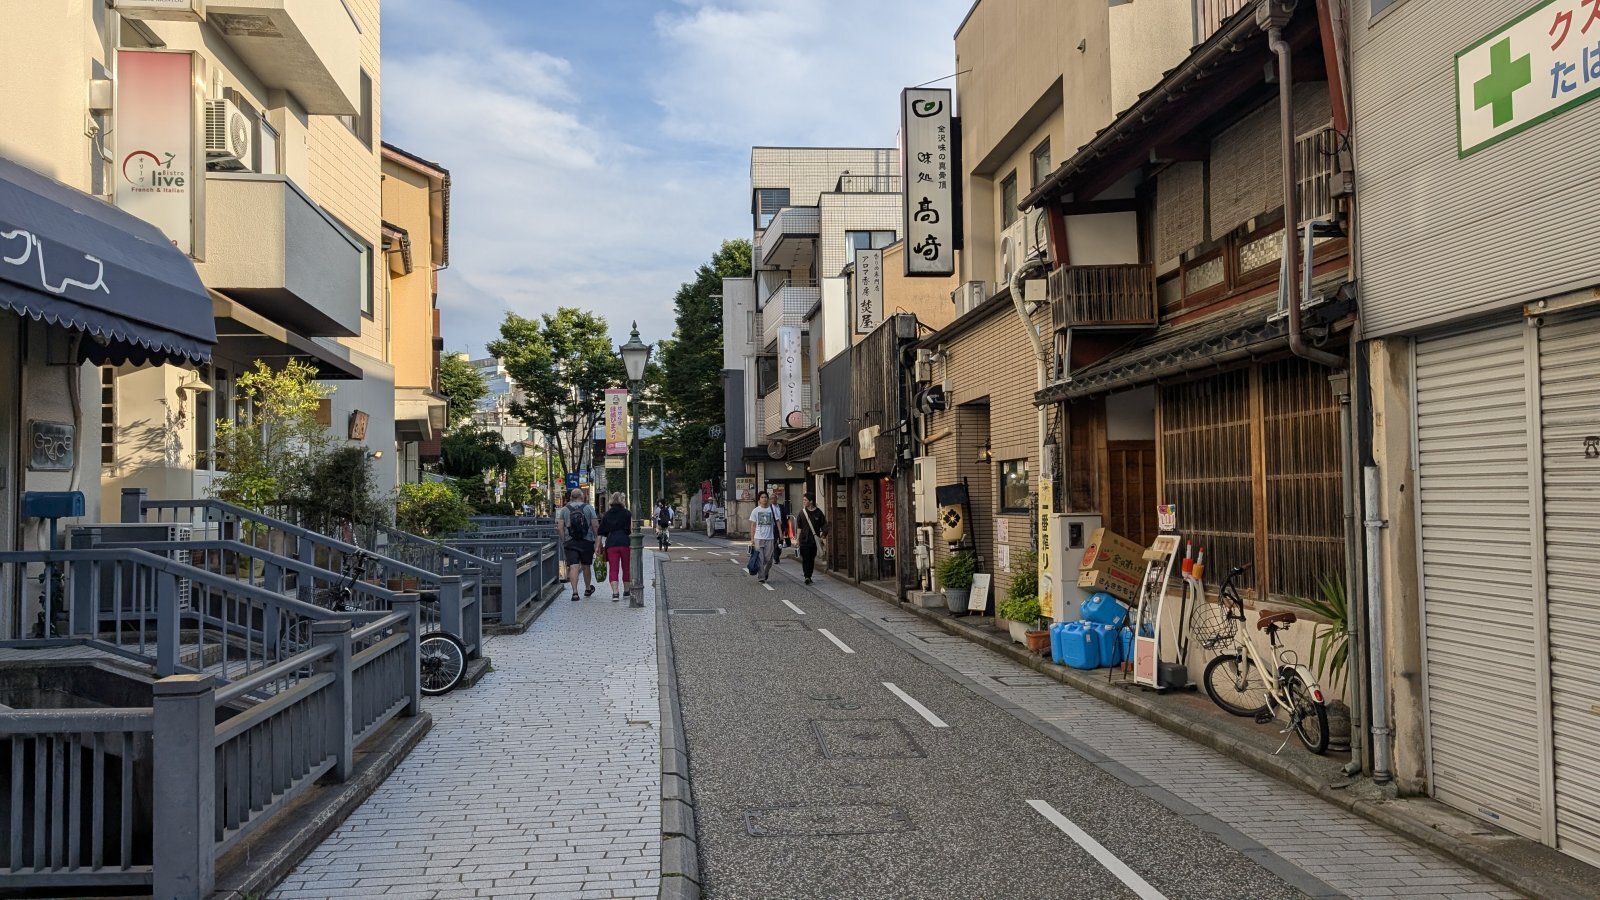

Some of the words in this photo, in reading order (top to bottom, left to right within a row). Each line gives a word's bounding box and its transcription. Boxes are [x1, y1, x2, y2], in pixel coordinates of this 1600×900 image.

[937, 125, 946, 189] 金沢味の真骨頂
